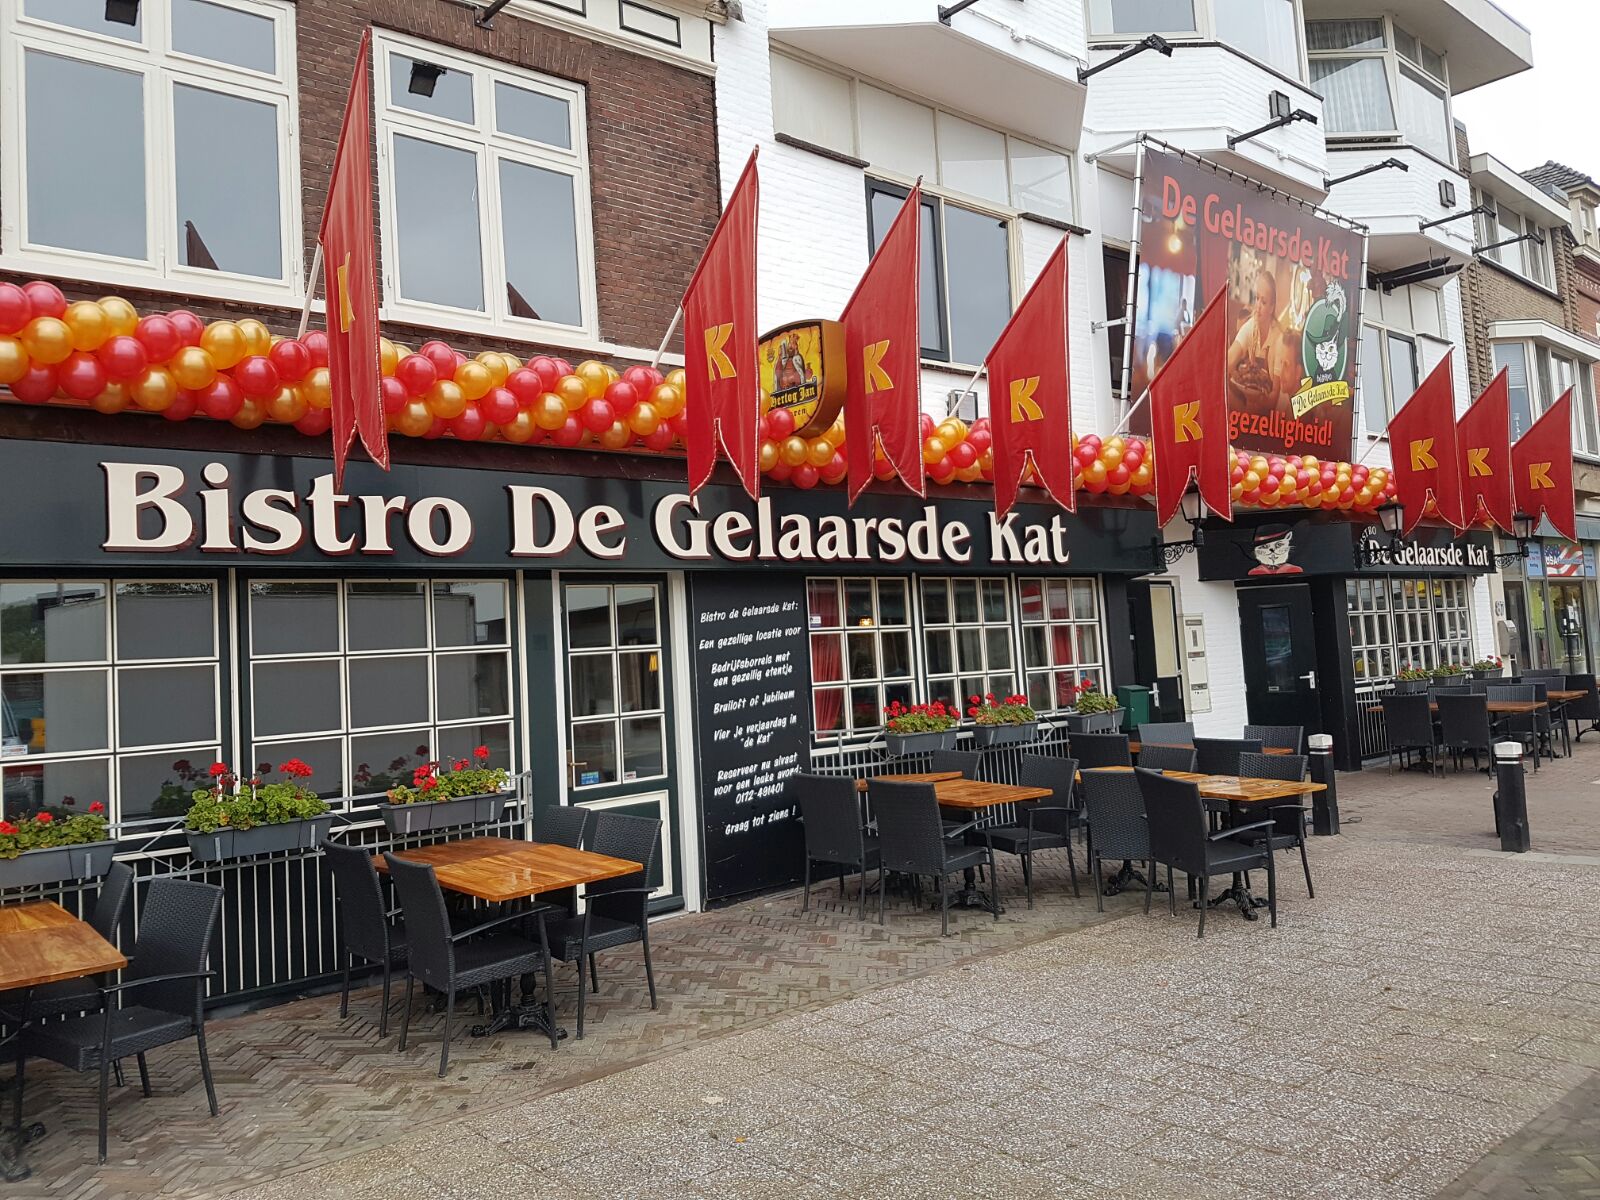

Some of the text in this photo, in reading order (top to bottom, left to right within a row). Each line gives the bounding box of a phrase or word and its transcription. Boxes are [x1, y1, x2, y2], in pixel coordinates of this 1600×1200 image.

[1162, 175, 1350, 280] De Gelaarsde Kat
[704, 322, 737, 382] K
[863, 339, 894, 394] K
[799, 386, 816, 401] Jan
[1009, 375, 1044, 424] K
[1173, 399, 1204, 443] K
[1229, 409, 1333, 448] gezelligheid!
[1409, 437, 1439, 472] K
[1467, 447, 1494, 477] K
[1528, 462, 1556, 490] K
[101, 461, 1071, 564] Bistro De Gelaarsde Kat
[1467, 543, 1490, 566] Kat
[700, 601, 799, 623] Bistro de Gelaarsde Kat:
[699, 626, 802, 650] Een gezellige locatie voor
[711, 651, 791, 674] Bedrijfsborrels met
[713, 663, 793, 687] een gezellig etentje
[713, 698, 747, 715] Bruiloft
[749, 694, 760, 707] of
[713, 713, 797, 742] Vier je verjaardag in
[717, 752, 798, 781] Reserveer nu alvast
[714, 783, 733, 796] voor
[735, 779, 751, 790] een
[753, 772, 775, 785] leuke
[735, 782, 784, 804] 0172-491401
[725, 804, 797, 836] Graag tot ziens !
